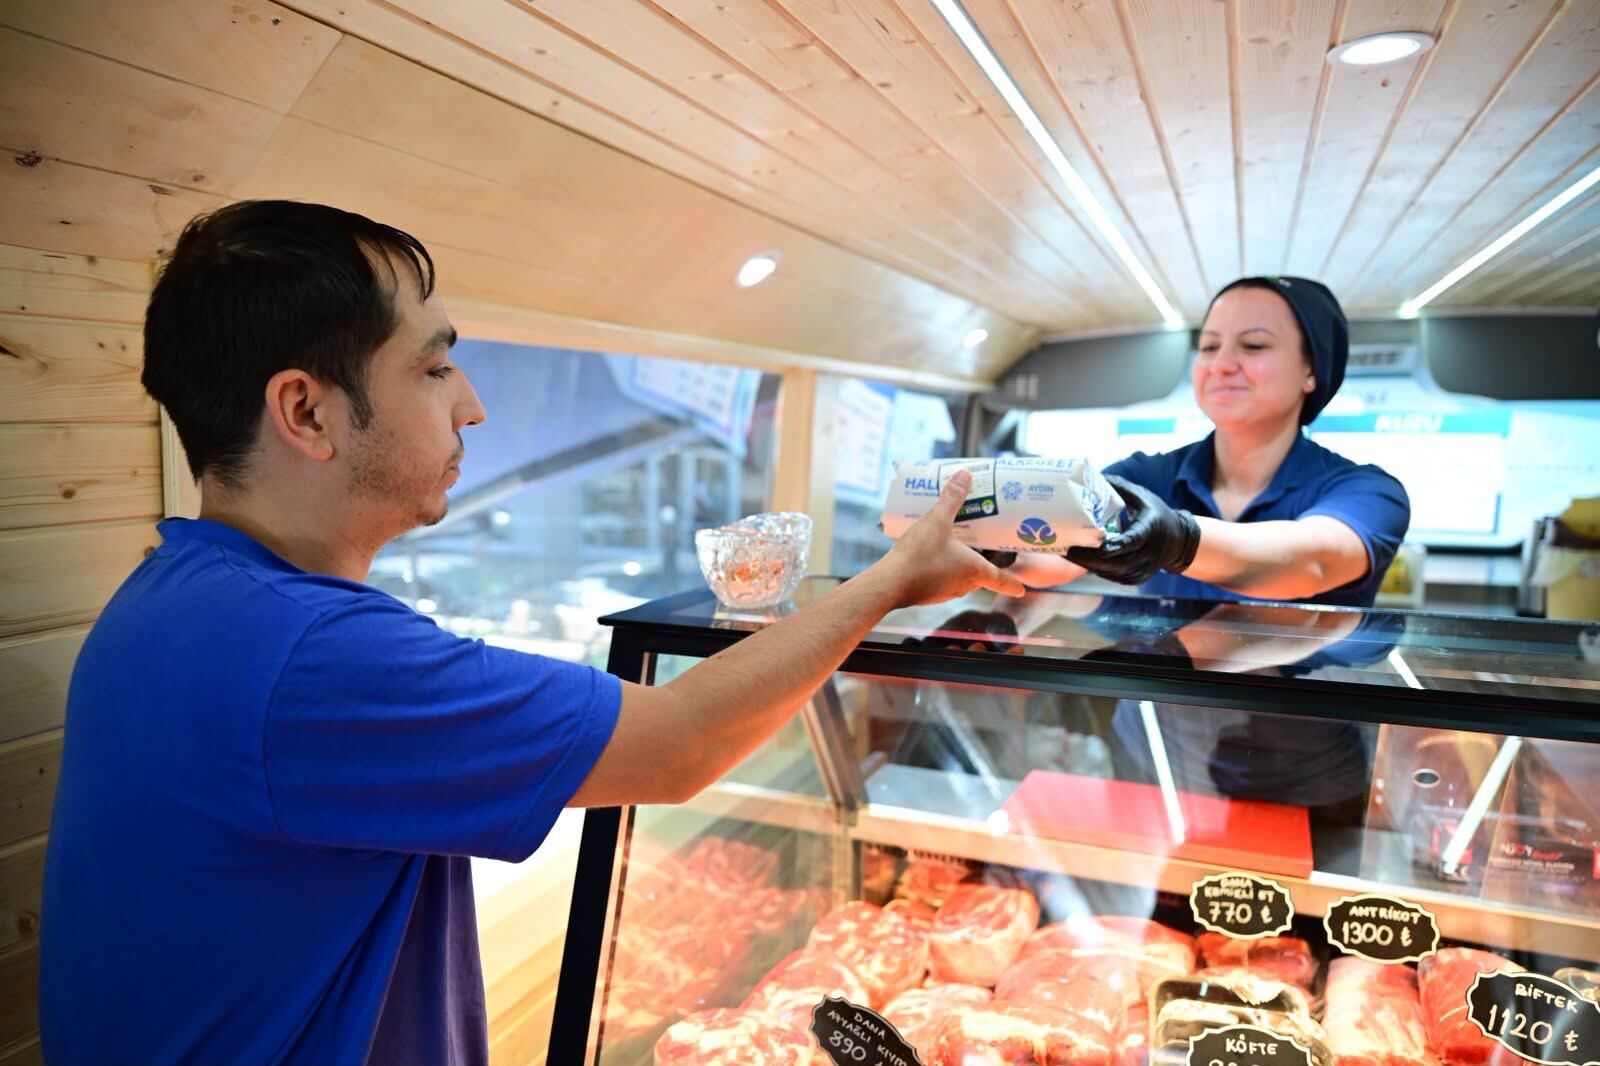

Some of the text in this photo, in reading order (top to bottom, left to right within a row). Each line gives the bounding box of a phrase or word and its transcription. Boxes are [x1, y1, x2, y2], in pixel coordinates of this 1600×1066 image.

[1208, 900, 1253, 925] 770
[1342, 921, 1394, 947] 1300
[1514, 982, 1579, 1014] BİFTEK
[854, 1012, 886, 1040] DANA
[1487, 1004, 1554, 1045] 1120
[828, 1030, 867, 1061] 890
